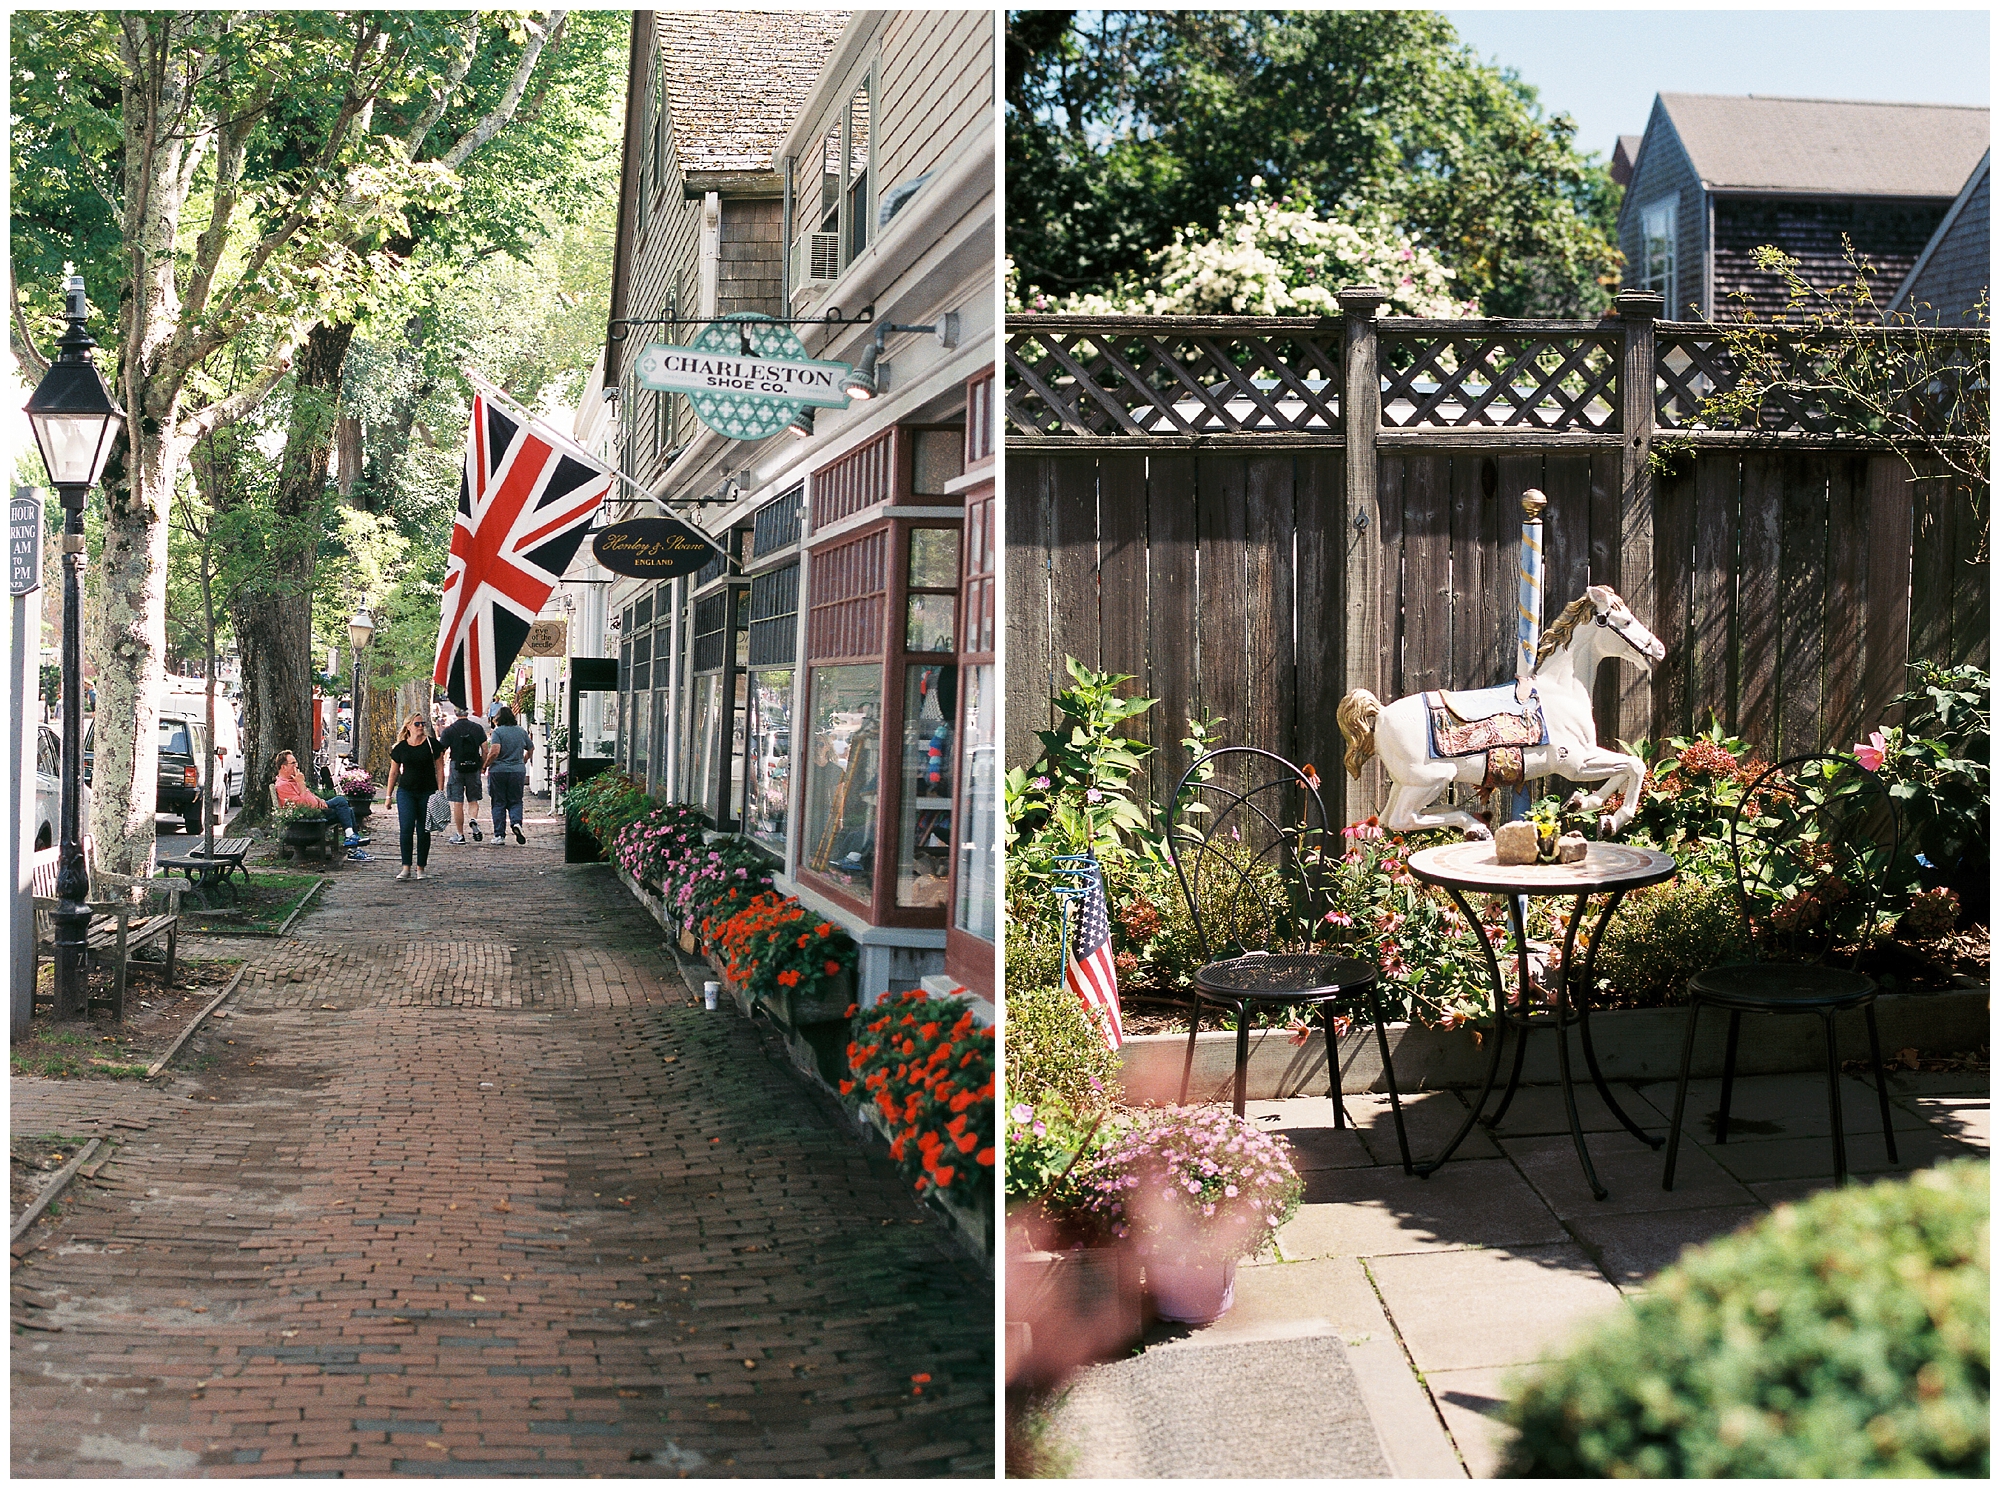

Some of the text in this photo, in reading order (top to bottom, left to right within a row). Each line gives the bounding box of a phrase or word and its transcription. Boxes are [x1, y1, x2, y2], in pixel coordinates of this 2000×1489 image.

[664, 355, 833, 387] CHARLESTON
[706, 376, 755, 390] SHOE
[760, 382, 788, 394] CO.
[11, 506, 35, 521] HOUR
[13, 541, 31, 554] AM
[13, 557, 22, 565] TO
[14, 567, 31, 579] PM
